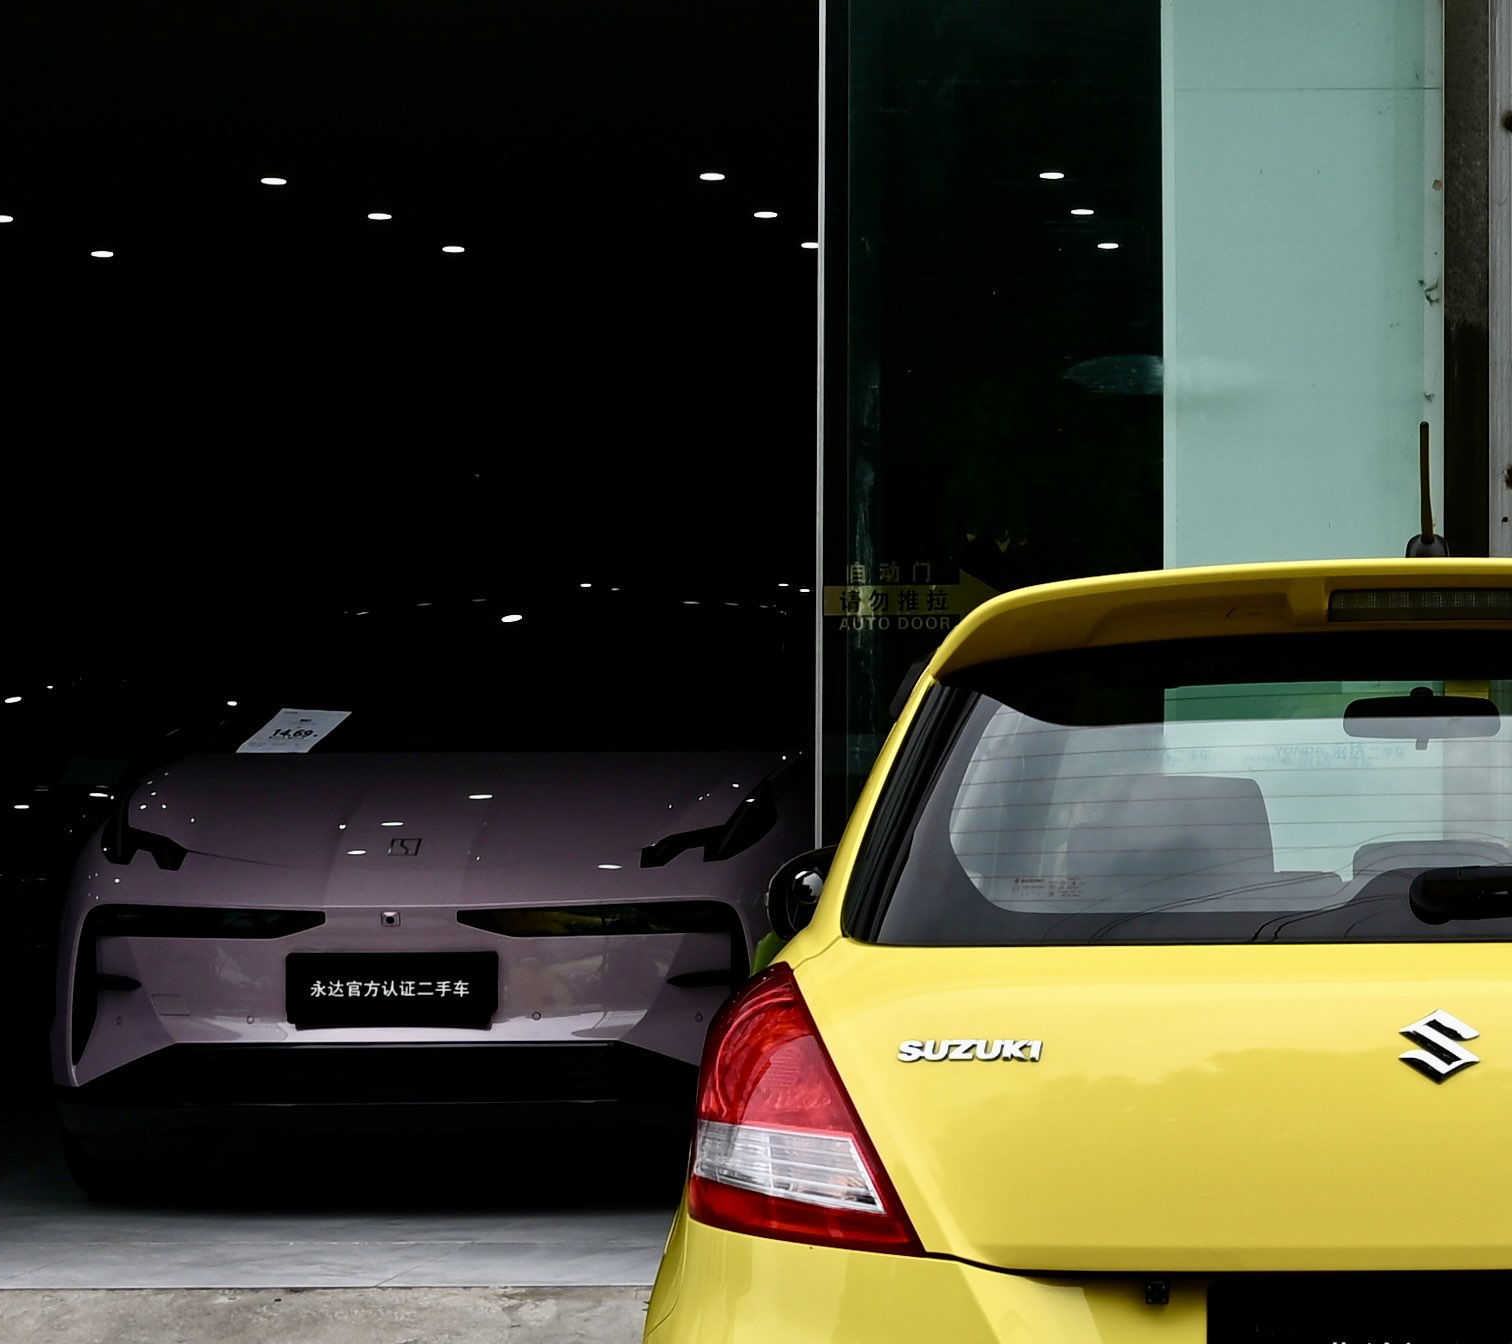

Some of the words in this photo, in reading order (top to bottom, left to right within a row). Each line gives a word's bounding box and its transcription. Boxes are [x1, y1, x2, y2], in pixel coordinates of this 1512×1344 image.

[847, 561, 931, 584] 自动门
[839, 589, 949, 612] 请勿推拉
[838, 616, 890, 631] AUTO
[897, 616, 951, 631] DOOR
[310, 979, 470, 998] 永达官方认证二手车
[897, 1039, 1043, 1062] SUZUKI
